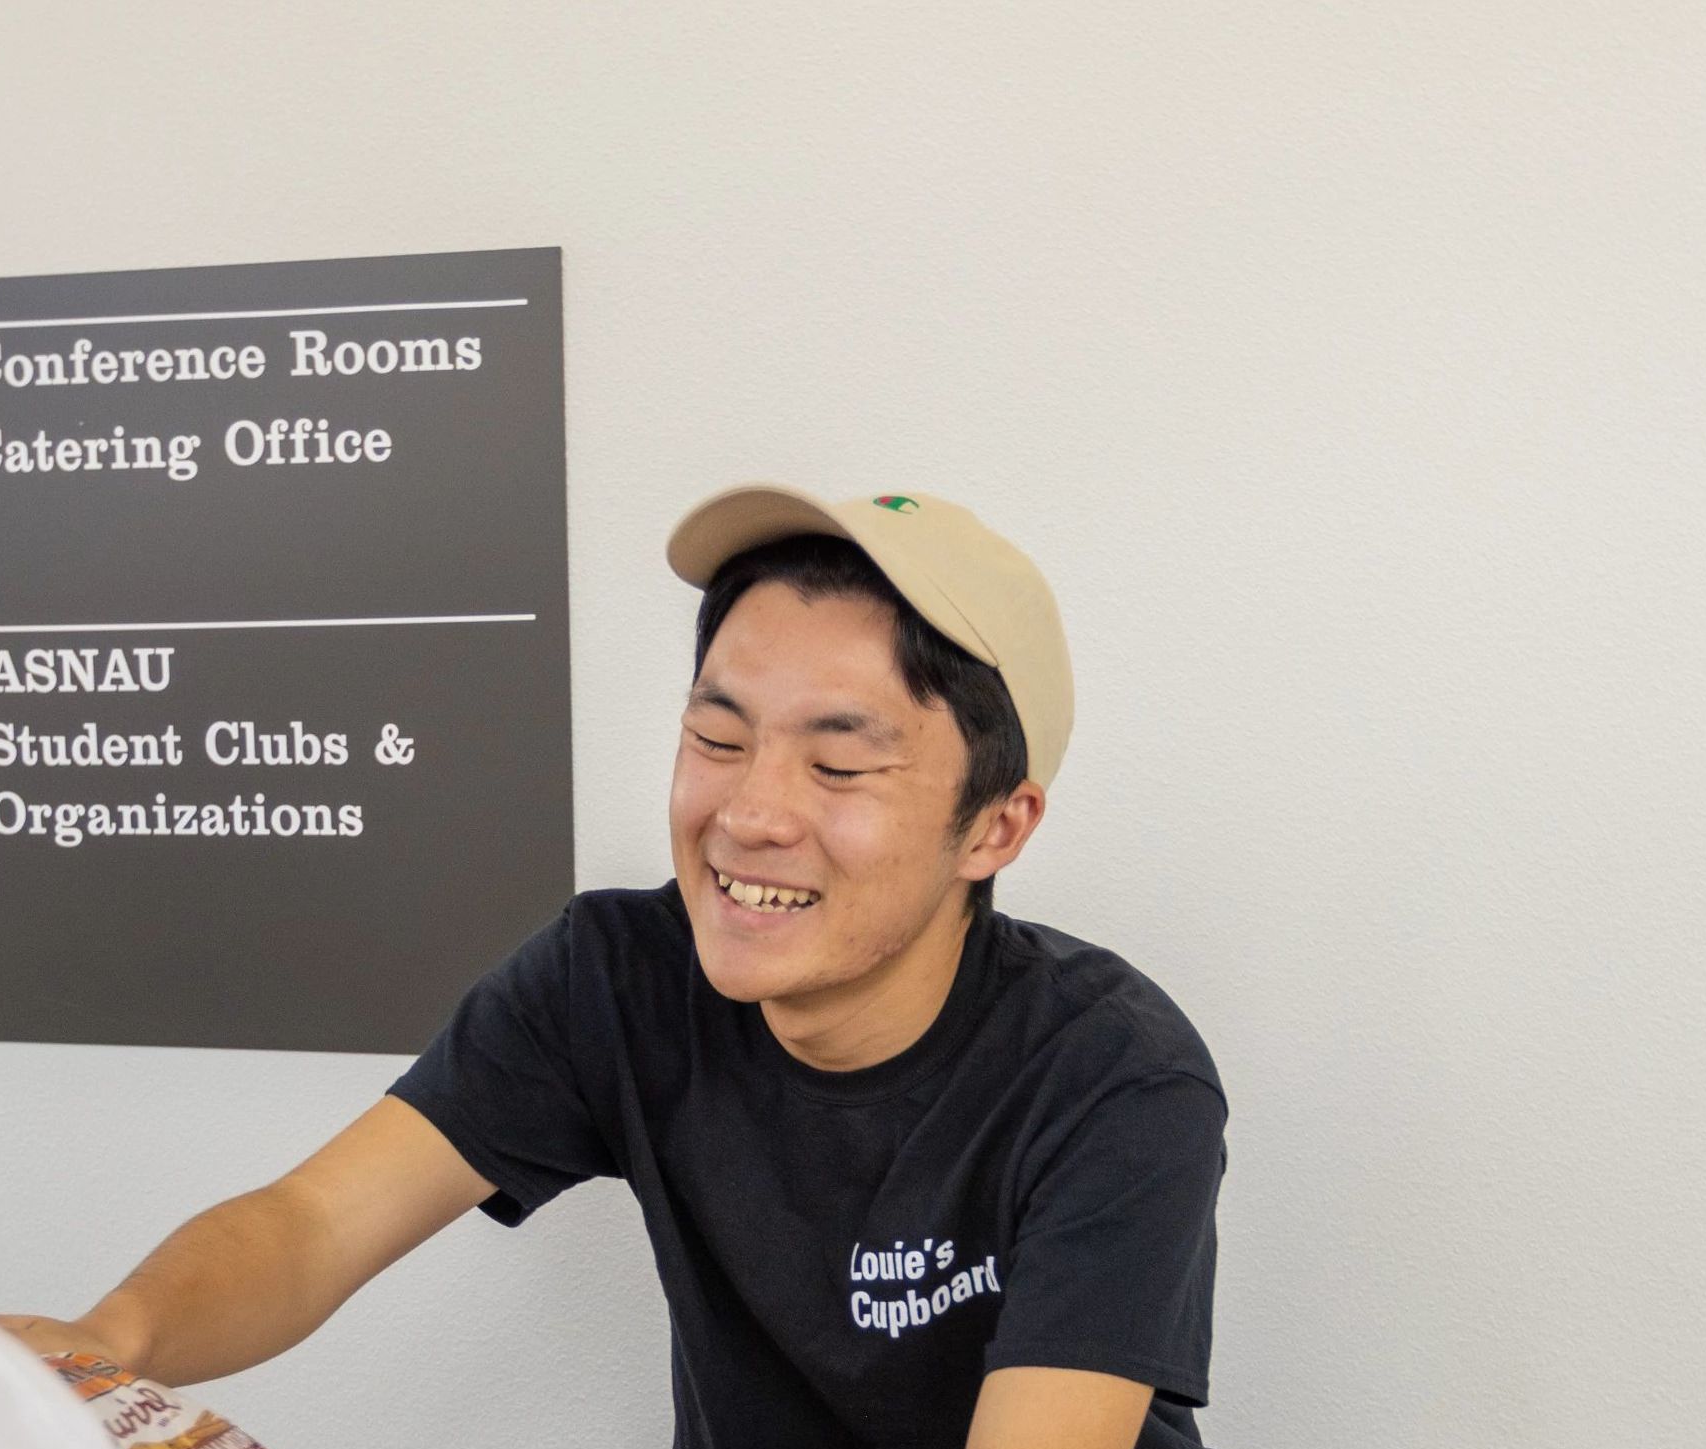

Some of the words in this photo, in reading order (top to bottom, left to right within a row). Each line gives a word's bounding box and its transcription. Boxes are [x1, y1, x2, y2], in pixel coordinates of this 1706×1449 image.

[289, 329, 484, 377] Rooms
[223, 417, 394, 467] Office
[204, 720, 350, 767] Clubs
[374, 723, 416, 766] &
[850, 1237, 956, 1282] Louie's
[850, 1255, 1002, 1339] Cupboard
